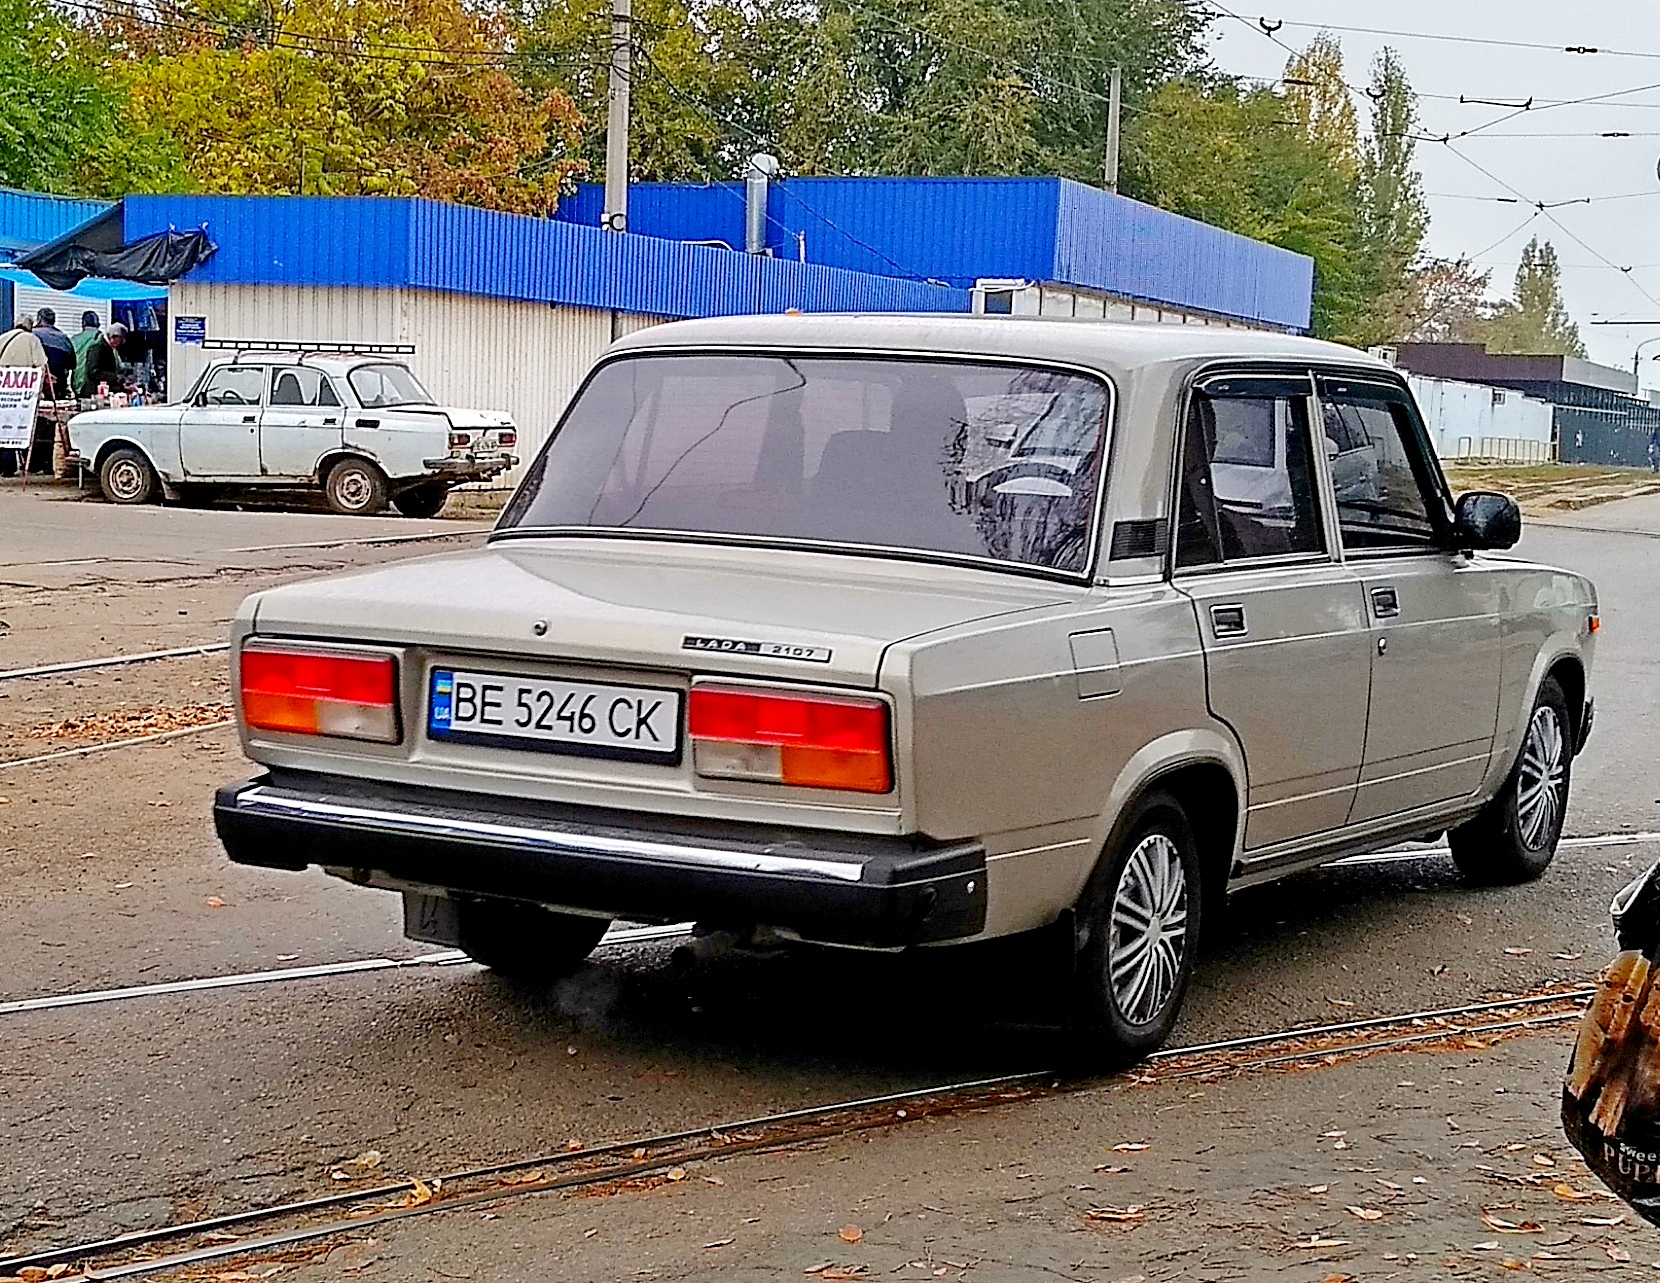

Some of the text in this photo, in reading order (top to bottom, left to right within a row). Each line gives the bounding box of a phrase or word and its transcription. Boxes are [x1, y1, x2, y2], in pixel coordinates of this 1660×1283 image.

[696, 638, 814, 657] LADA 2107
[454, 682, 665, 742] BE 5246 CK
[1619, 1142, 1660, 1162] swee
